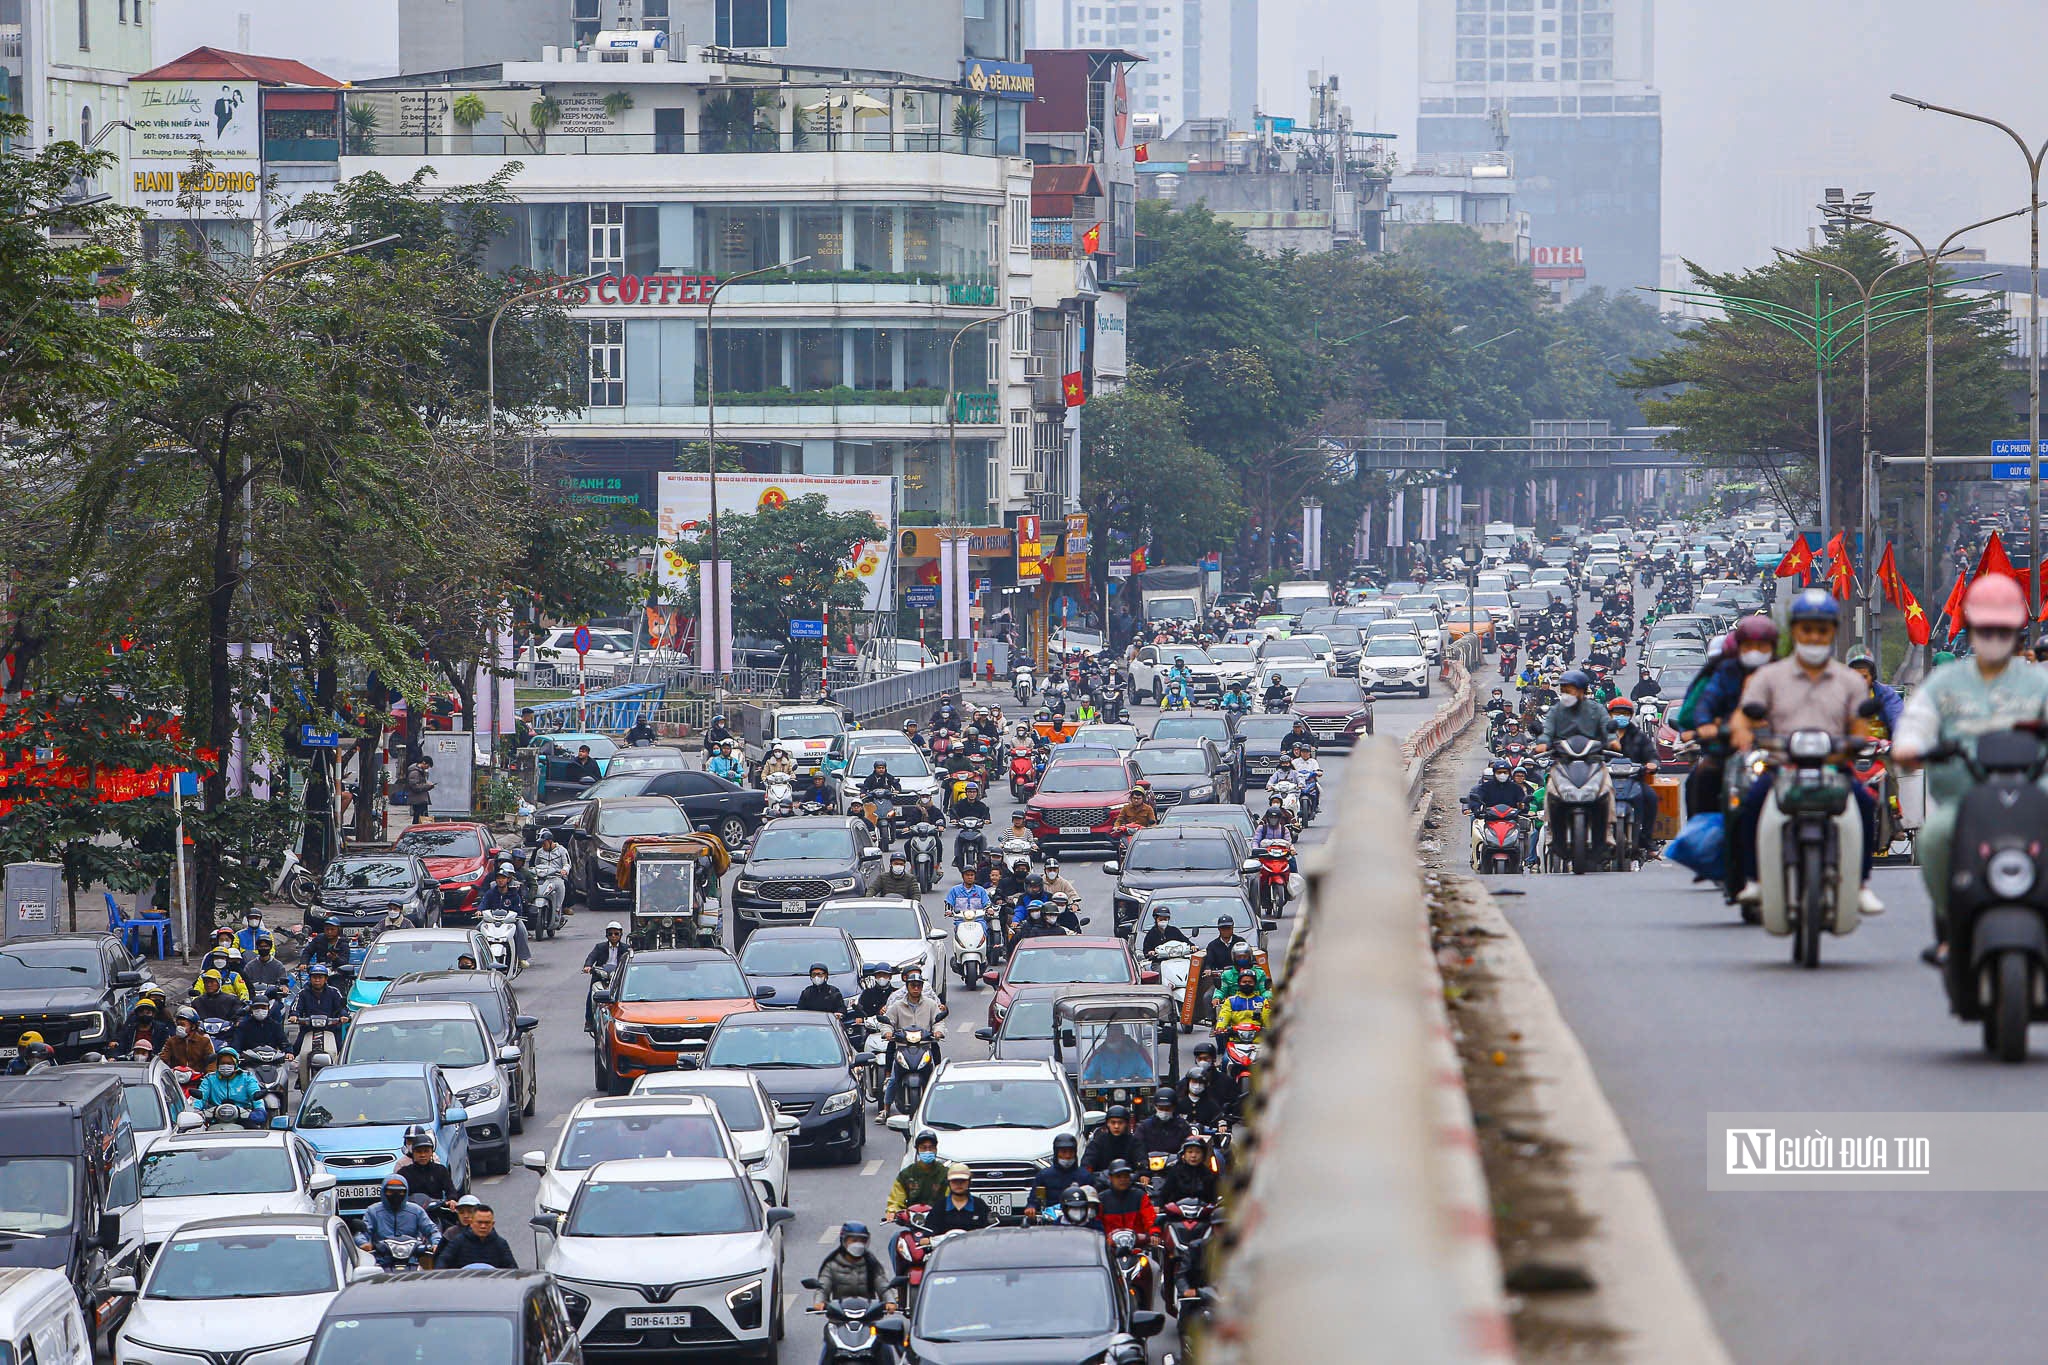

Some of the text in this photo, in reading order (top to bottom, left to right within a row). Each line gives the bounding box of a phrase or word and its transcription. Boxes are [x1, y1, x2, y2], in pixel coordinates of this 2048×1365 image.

[1009, 75, 1035, 93] XANH
[133, 171, 173, 192] HANI
[145, 199, 174, 207] PHOTO
[215, 199, 244, 207] BRIDAL
[598, 274, 717, 305] COFFEE
[1996, 443, 2009, 453] CÁC
[2009, 466, 2023, 475] QUY
[607, 478, 622, 489] 28
[988, 1195, 1004, 1205] 30F
[631, 1315, 686, 1327] 30M-641.35
